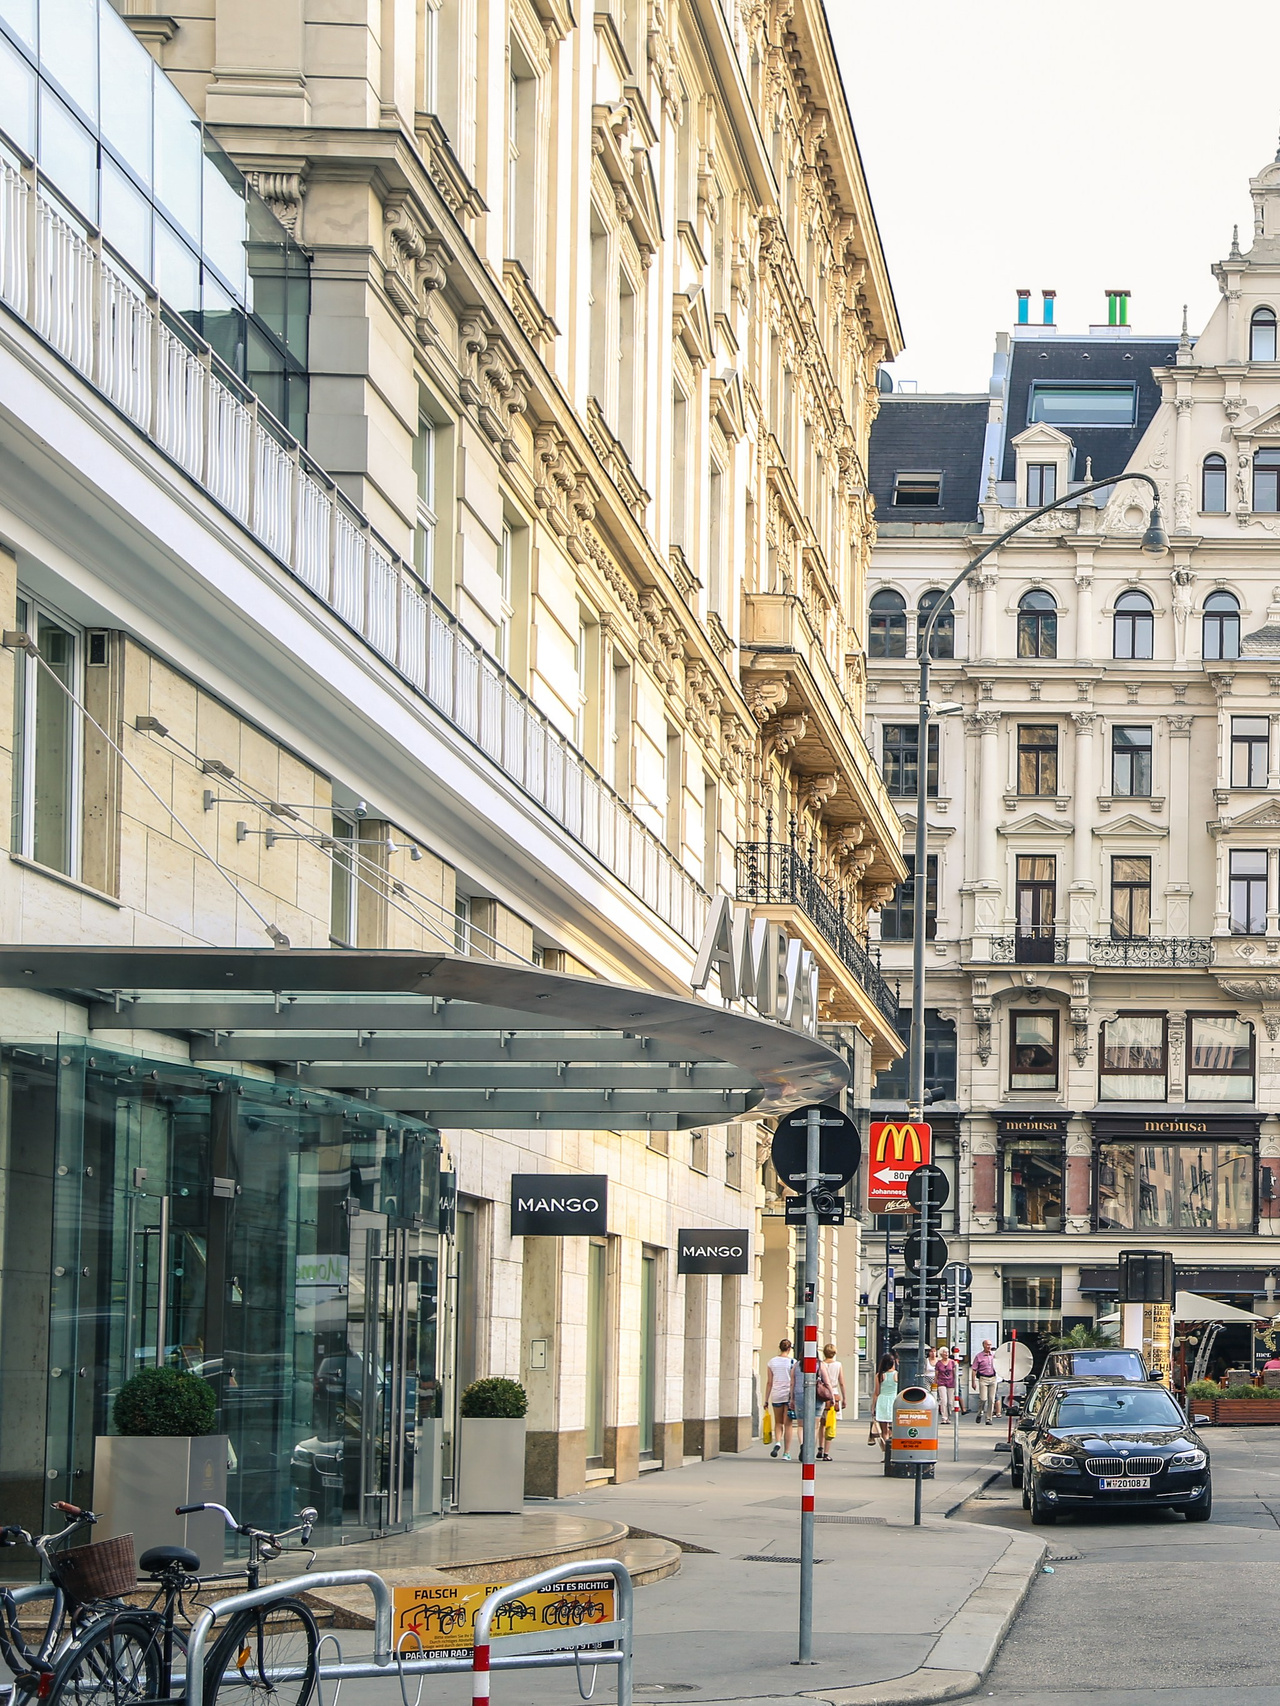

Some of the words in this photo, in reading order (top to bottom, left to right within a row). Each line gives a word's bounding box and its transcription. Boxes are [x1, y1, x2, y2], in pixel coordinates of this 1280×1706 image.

[518, 1197, 600, 1213] MANGO
[682, 1245, 743, 1258] MANGO
[1106, 1479, 1112, 1488] W
[1118, 1479, 1141, 1488] 20108
[1142, 1479, 1147, 1487] Z
[554, 1583, 565, 1592] IST
[566, 1582, 577, 1591] ES
[577, 1581, 609, 1590] RICHTIG
[414, 1588, 458, 1600] FALSCH
[405, 1651, 428, 1660] PARK
[429, 1650, 449, 1659] DEIN
[450, 1649, 468, 1657] RAD
